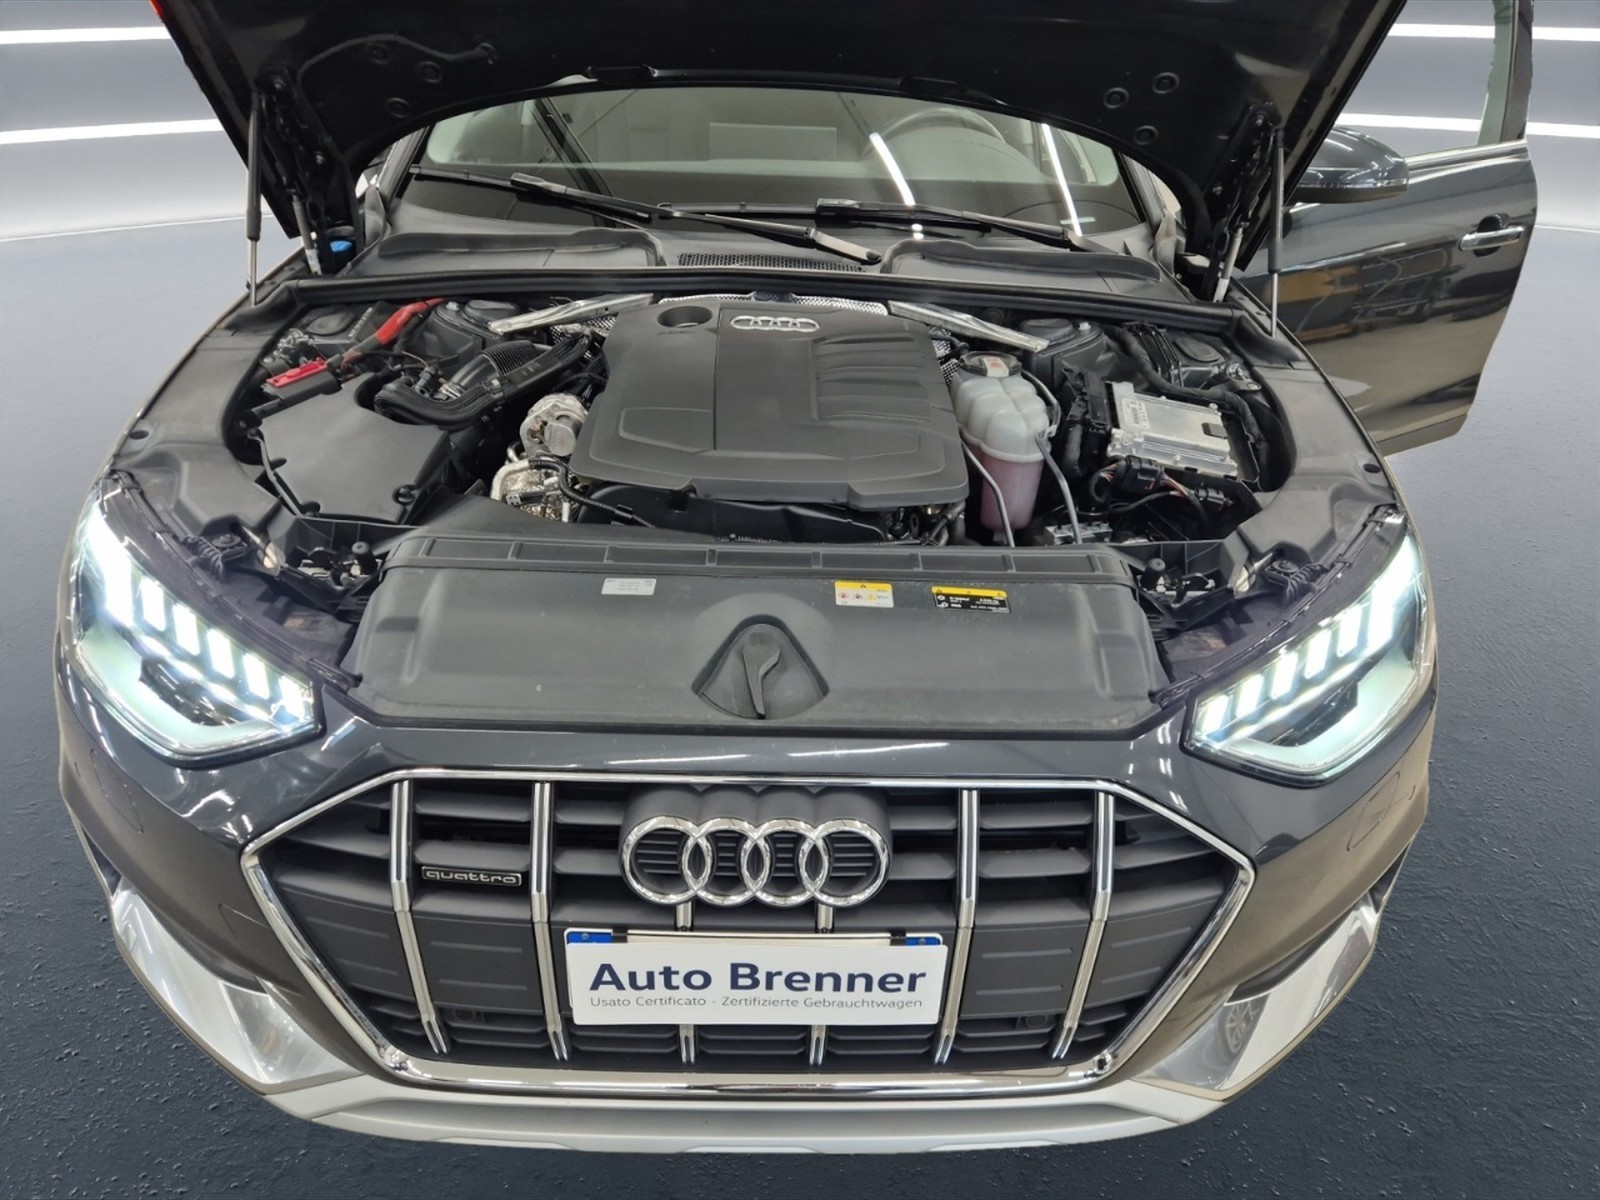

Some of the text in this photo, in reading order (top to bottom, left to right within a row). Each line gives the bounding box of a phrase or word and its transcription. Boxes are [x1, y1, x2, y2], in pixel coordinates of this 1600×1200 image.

[425, 870, 517, 884] quattro
[589, 962, 927, 993] Auto Brenner
[590, 997, 631, 1007] Usato
[635, 996, 707, 1007] Certificato
[721, 996, 799, 1008] Zertifizierte
[803, 997, 923, 1010] Gebrauchtwagen
